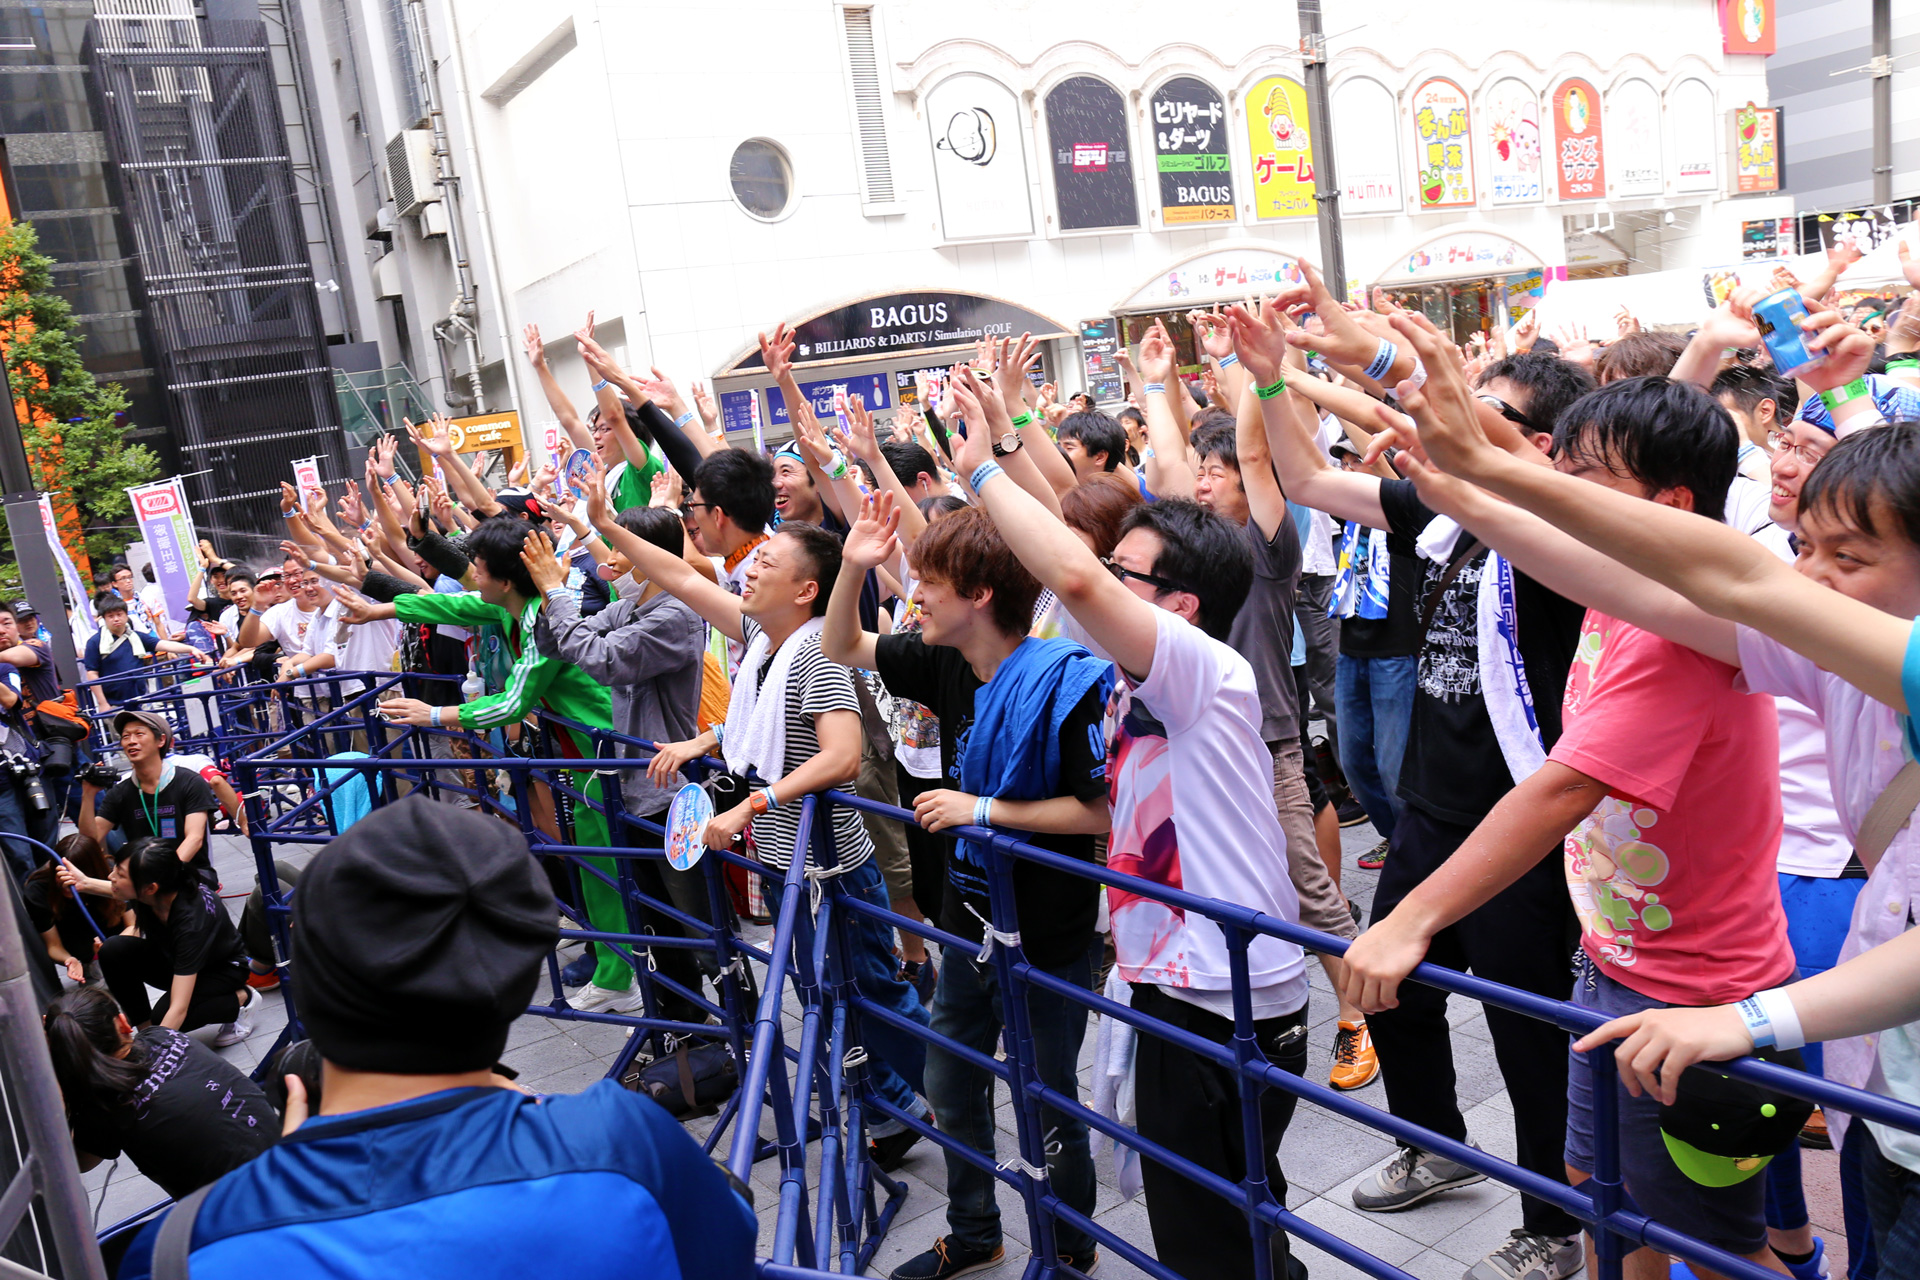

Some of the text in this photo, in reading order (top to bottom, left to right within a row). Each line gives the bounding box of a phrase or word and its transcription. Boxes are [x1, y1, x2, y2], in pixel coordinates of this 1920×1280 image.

[1154, 101, 1223, 124] ビリヤード
[1416, 107, 1468, 140] まんが
[1158, 128, 1211, 150] &ダーツ
[1561, 136, 1598, 159] メンズ
[1194, 155, 1226, 170] ゴルフ
[1255, 154, 1315, 184] ゲーム
[1562, 159, 1599, 181] サウナ
[1177, 186, 1231, 203] BAGUS
[1348, 184, 1394, 201] HUMAX
[1448, 245, 1474, 264] ゲーム
[1215, 265, 1248, 287] ゲーム
[870, 302, 948, 329] BAGUS
[815, 337, 876, 354] BILLIARDS
[878, 336, 888, 346] &
[889, 331, 926, 346] DARTS
[934, 326, 982, 341] Simulation
[984, 322, 1012, 336] GOLF
[465, 420, 512, 433] common
[479, 430, 502, 442] cafe
